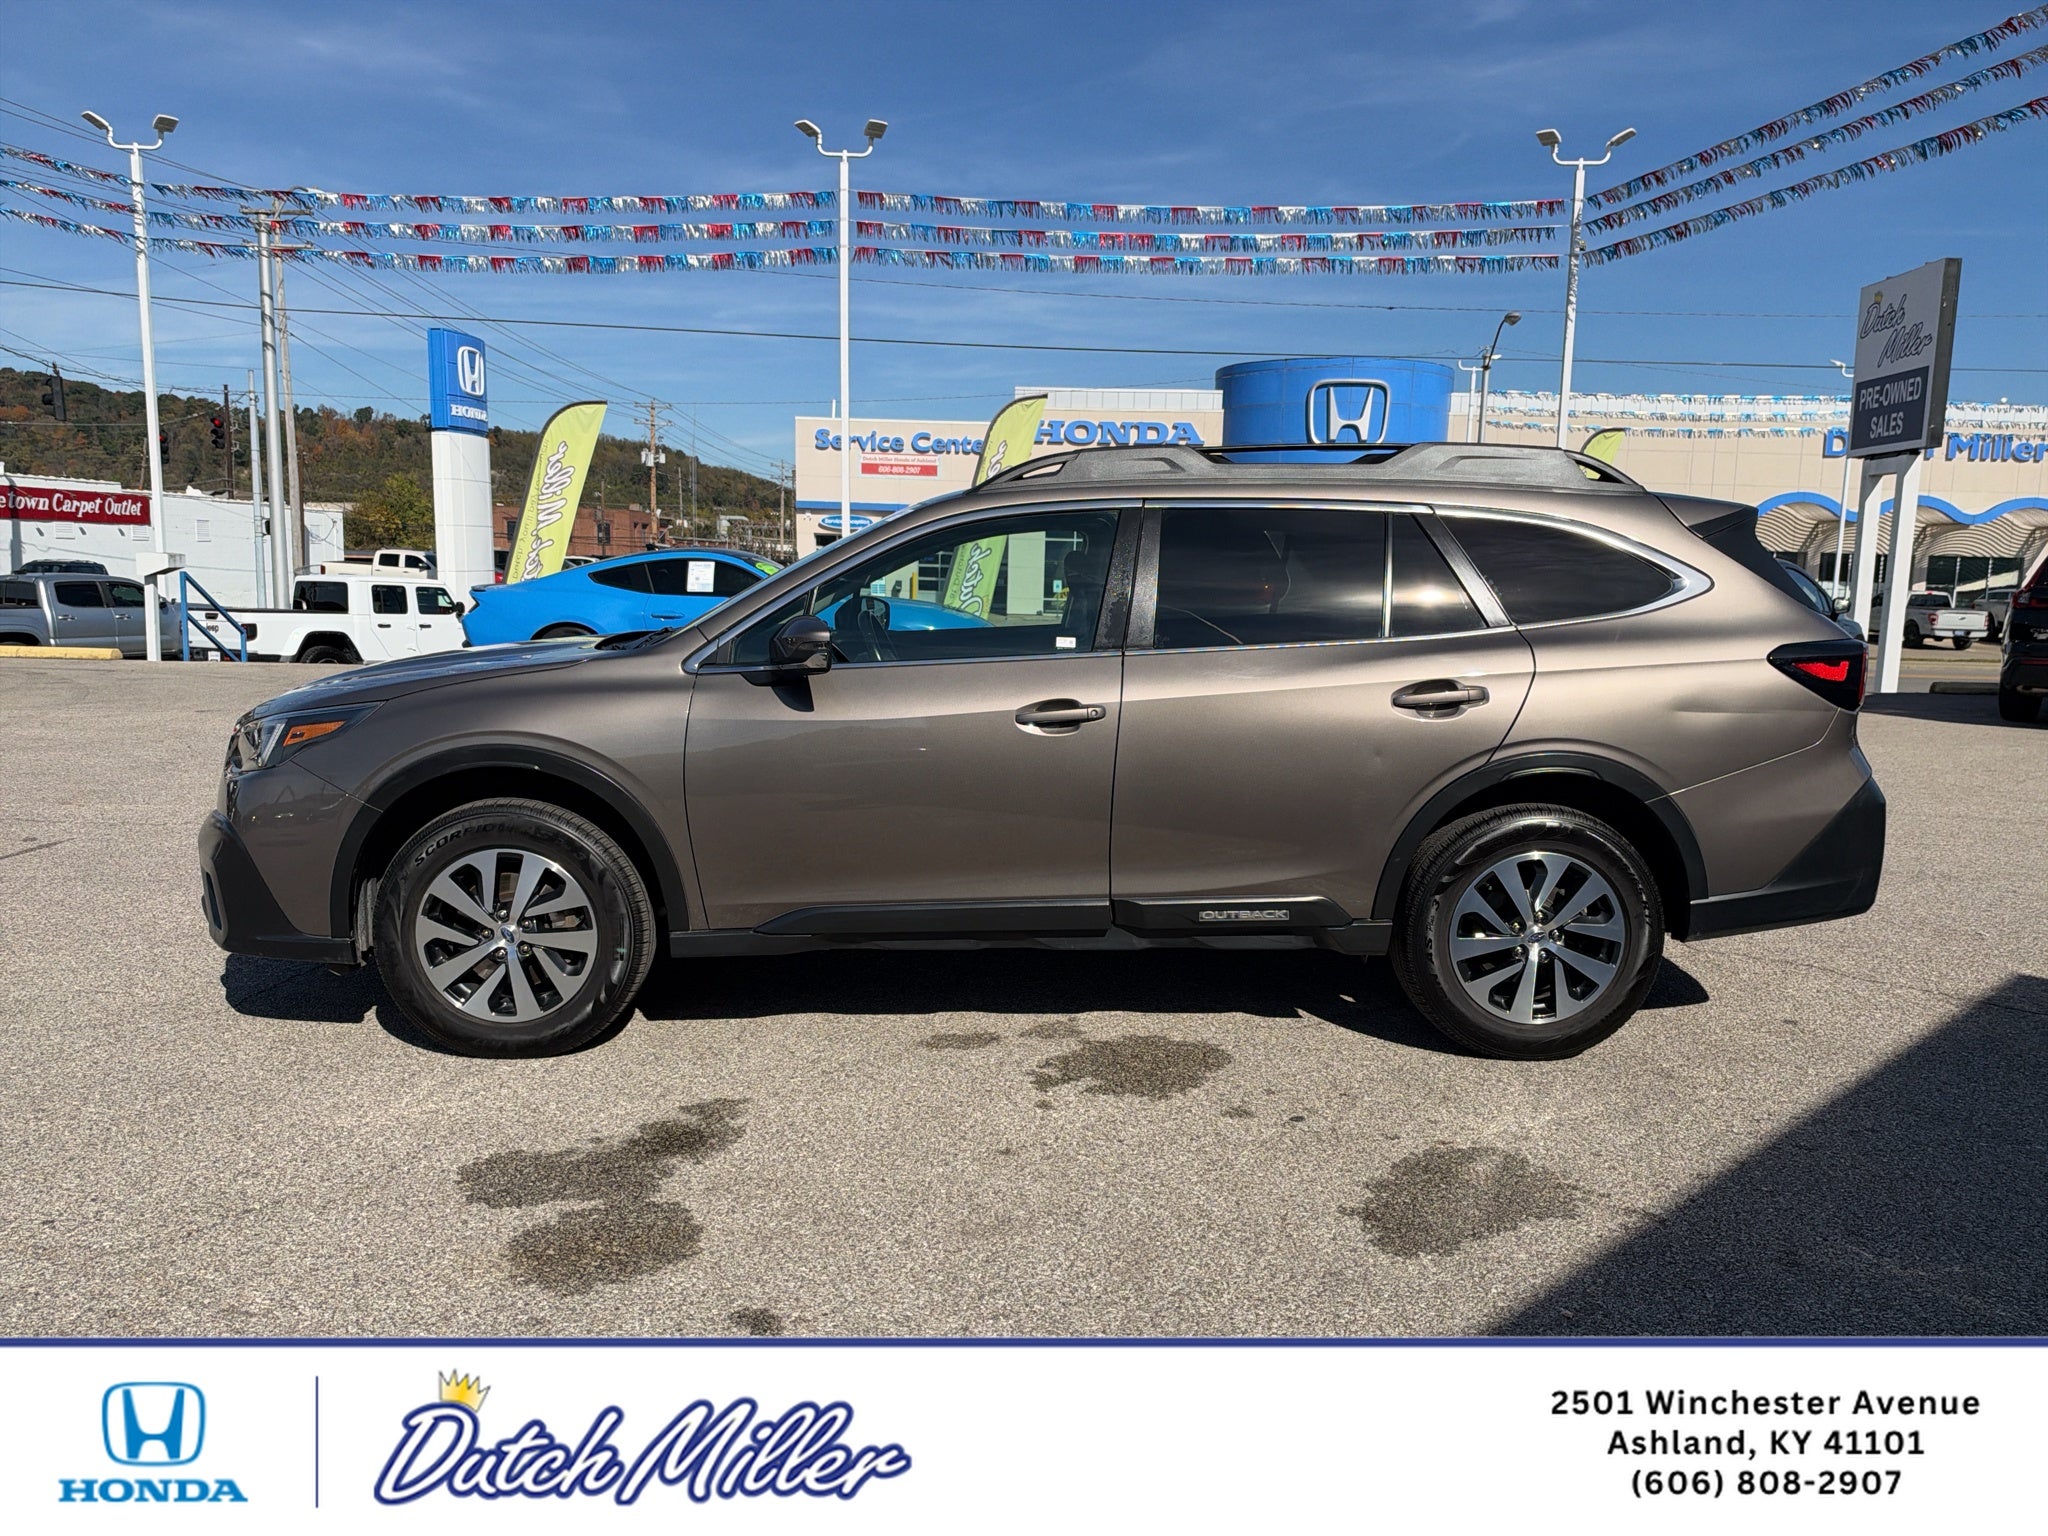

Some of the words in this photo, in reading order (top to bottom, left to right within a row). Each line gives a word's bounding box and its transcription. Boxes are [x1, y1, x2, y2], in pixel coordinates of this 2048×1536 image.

[1860, 294, 1907, 339] Dutch
[1877, 322, 1933, 368] Miller
[1859, 376, 1922, 412] PRE-OWNED
[1034, 420, 1205, 446] HONDA
[1870, 411, 1904, 439] SALES
[911, 432, 984, 455] Cente
[52, 493, 102, 518] Carpet
[104, 498, 142, 516] Outlet
[414, 822, 514, 867] SCORPION
[1201, 910, 1287, 920] OUTBACK
